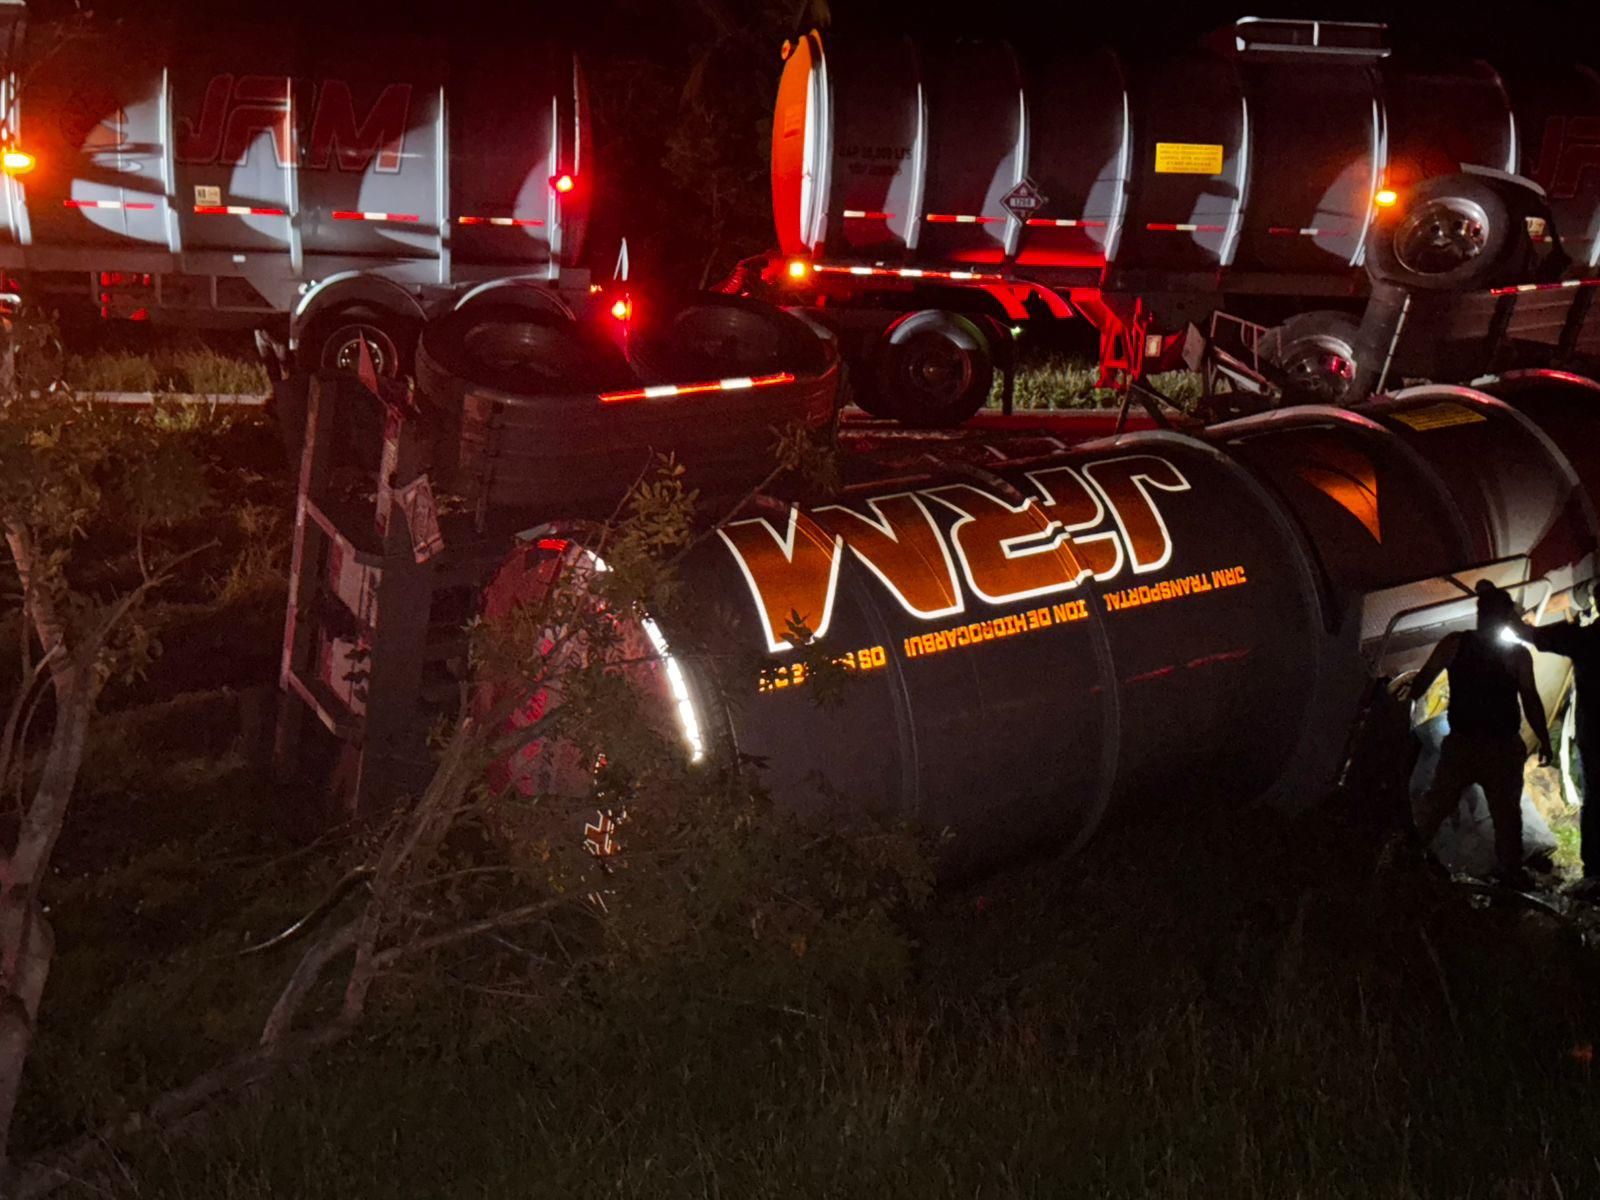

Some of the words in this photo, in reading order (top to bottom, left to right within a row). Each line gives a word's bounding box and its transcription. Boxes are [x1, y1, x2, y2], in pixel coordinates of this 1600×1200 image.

[716, 455, 1191, 653] JRM
[1211, 566, 1247, 590] JRM
[1026, 606, 1051, 630] DE
[858, 615, 1028, 669] HIDROCARBUOS
